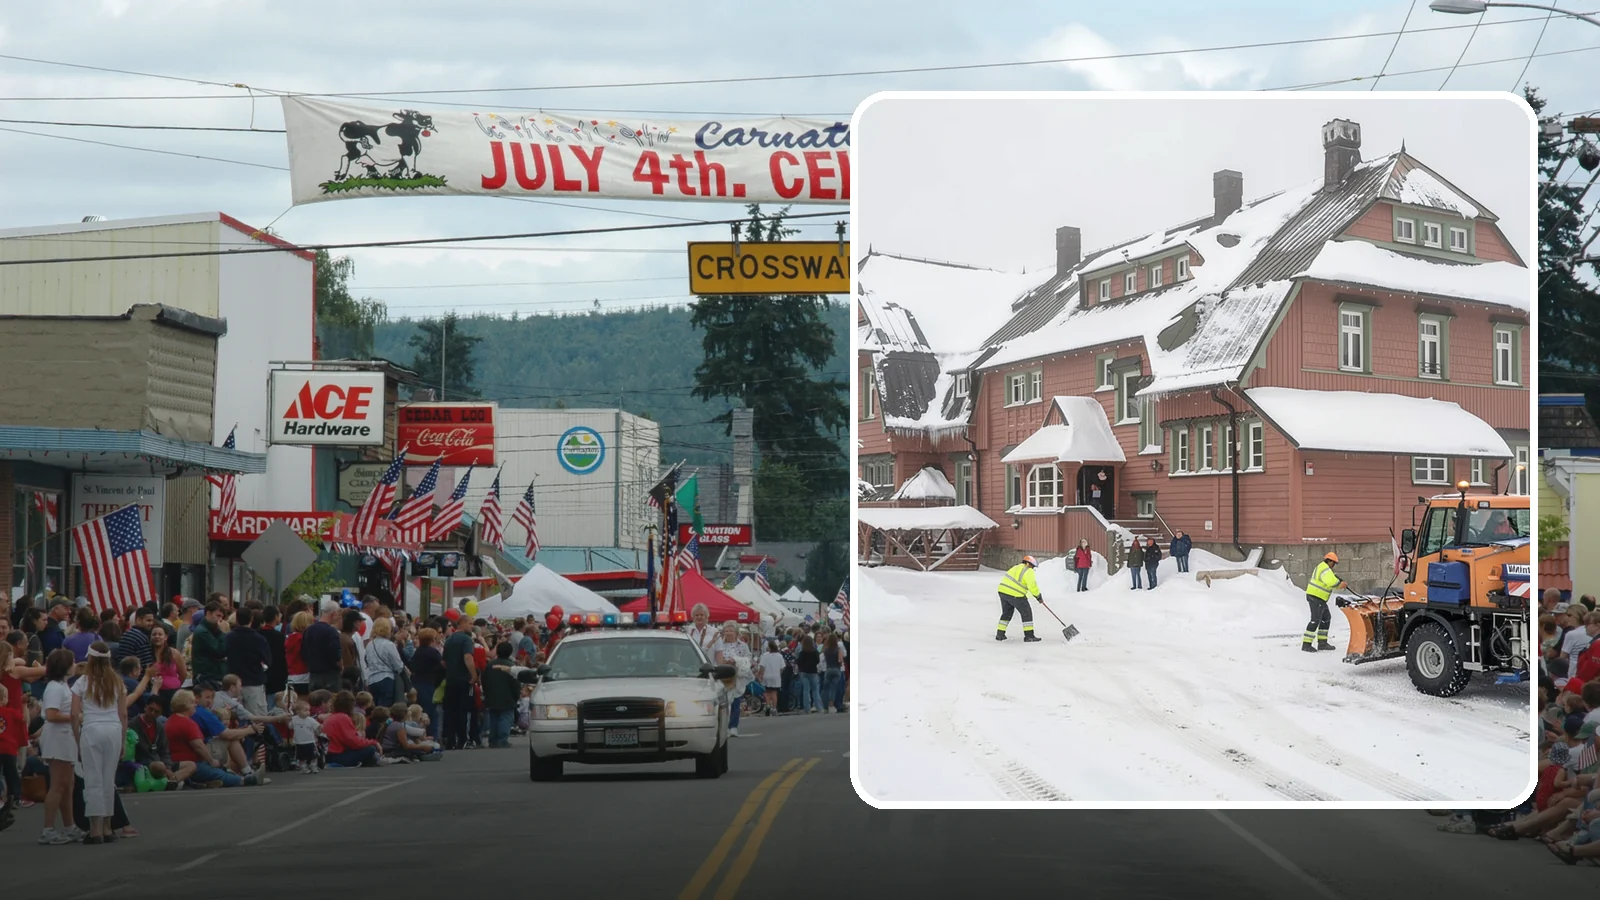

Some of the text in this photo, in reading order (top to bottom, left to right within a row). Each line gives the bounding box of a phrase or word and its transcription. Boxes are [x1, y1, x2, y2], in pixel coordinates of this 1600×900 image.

[481, 141, 605, 192] JULY
[632, 151, 746, 197] 4th.
[697, 254, 850, 280] CROSSWA
[283, 380, 374, 420] ACE
[406, 409, 452, 422] CEDAR
[283, 421, 370, 437] Hardware
[416, 428, 477, 447] Coca-Cola
[83, 485, 155, 495] St. Vincent de Paul
[688, 526, 741, 535] CRNATION
[699, 535, 730, 543] GLASS
